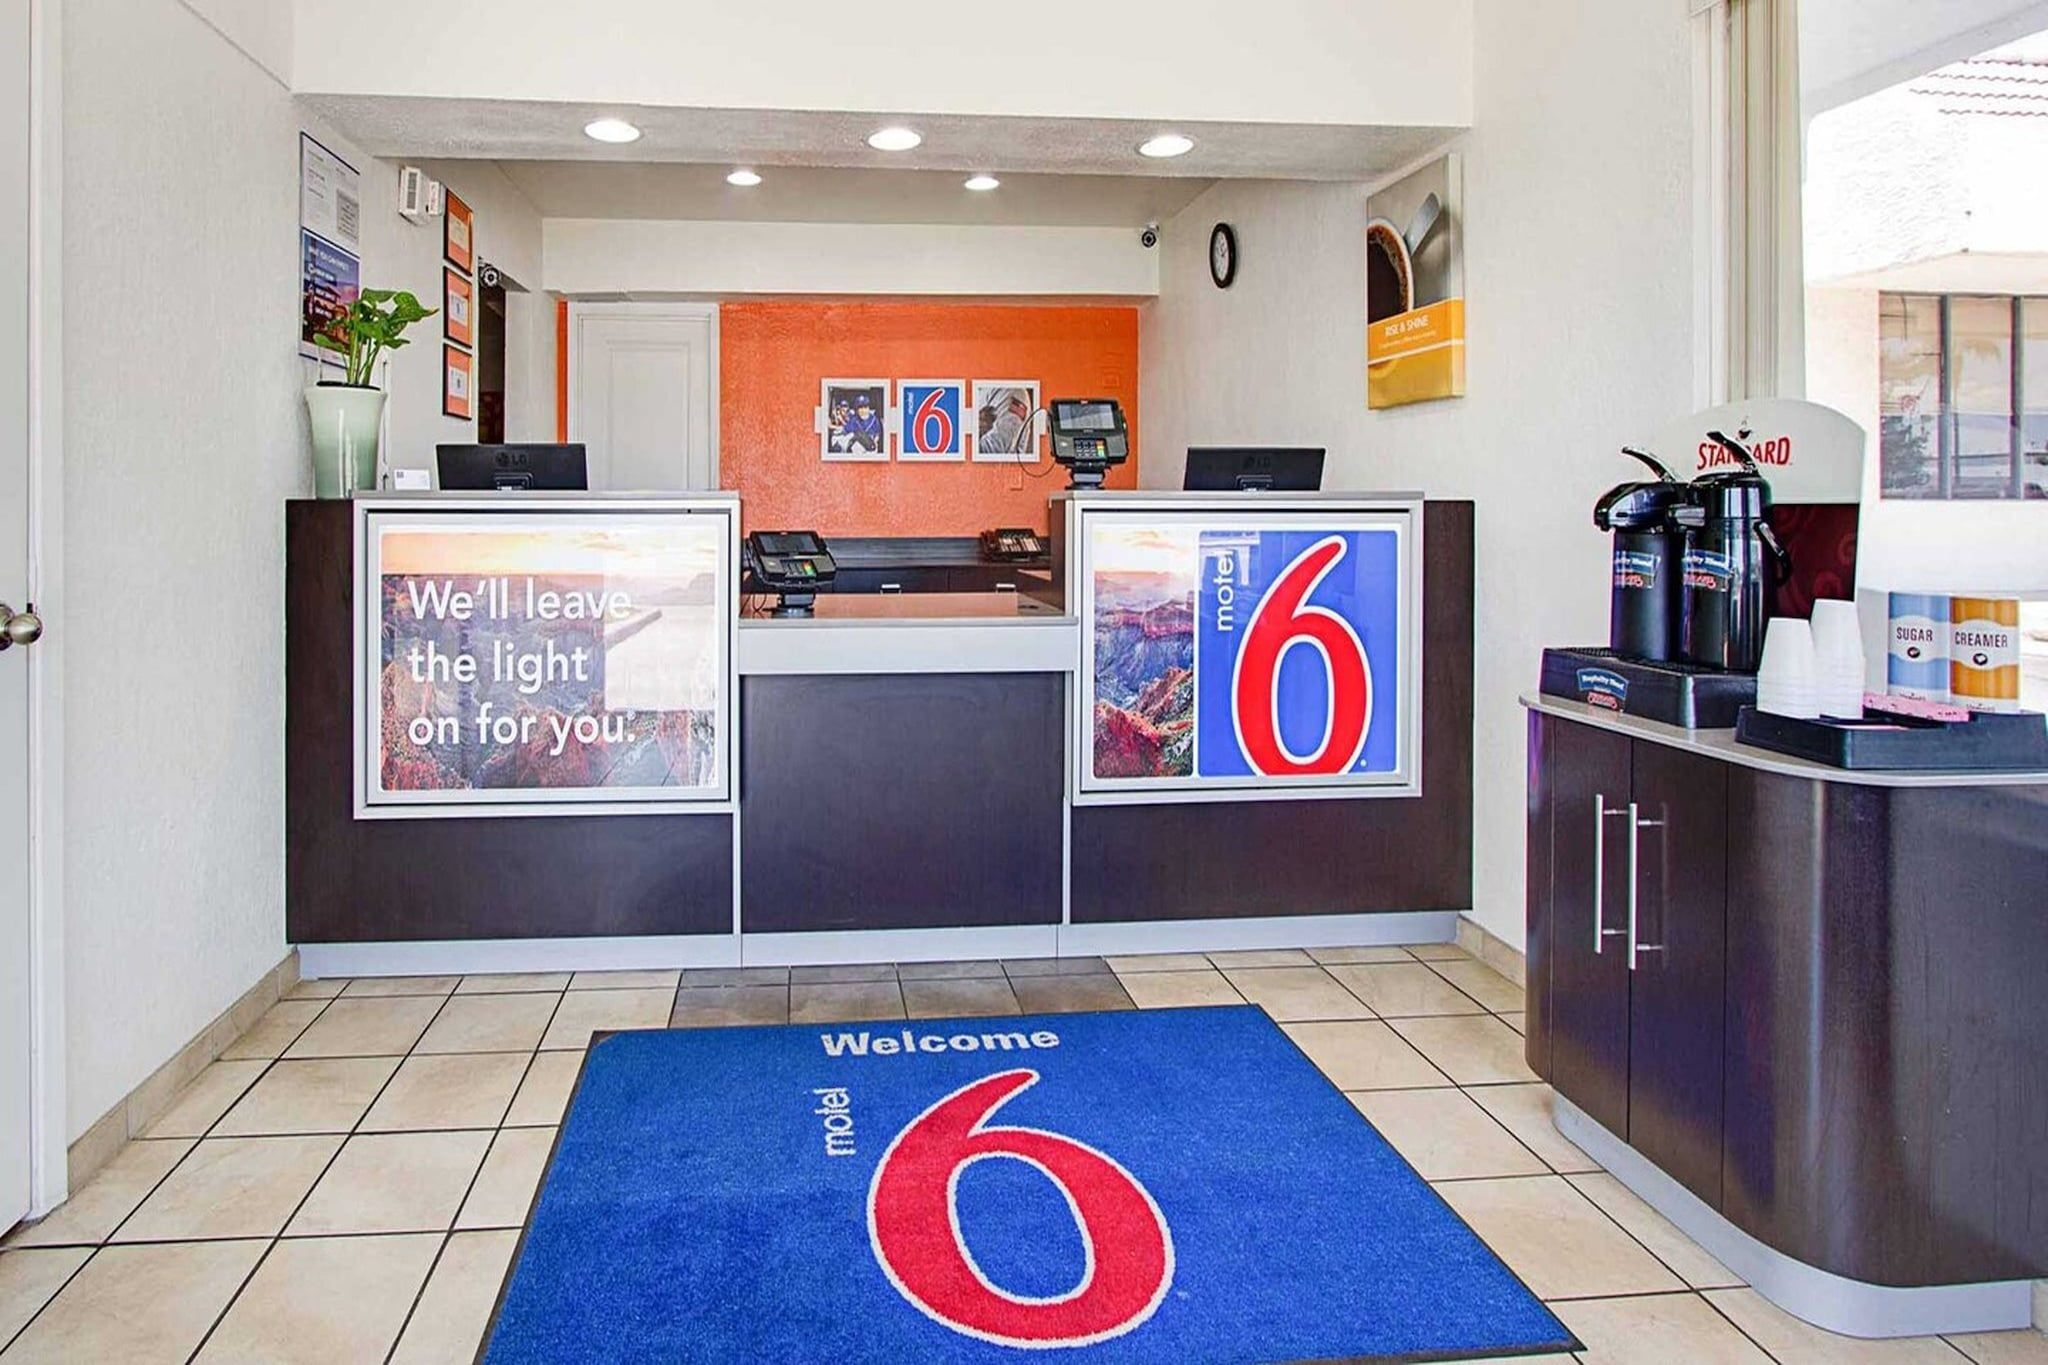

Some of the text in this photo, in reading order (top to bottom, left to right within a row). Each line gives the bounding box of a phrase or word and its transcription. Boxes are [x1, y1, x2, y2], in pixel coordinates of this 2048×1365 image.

[912, 388, 953, 455] 6
[407, 578, 631, 621] We'll leave
[1213, 535, 1373, 776] motel 6
[1896, 626, 1934, 642] SUGAR
[1954, 631, 2008, 648] CREAMER
[407, 640, 589, 695] the light
[408, 703, 637, 756] on for you.
[820, 1029, 1060, 1057] Welcome
[813, 1068, 1175, 1350] motel 6
